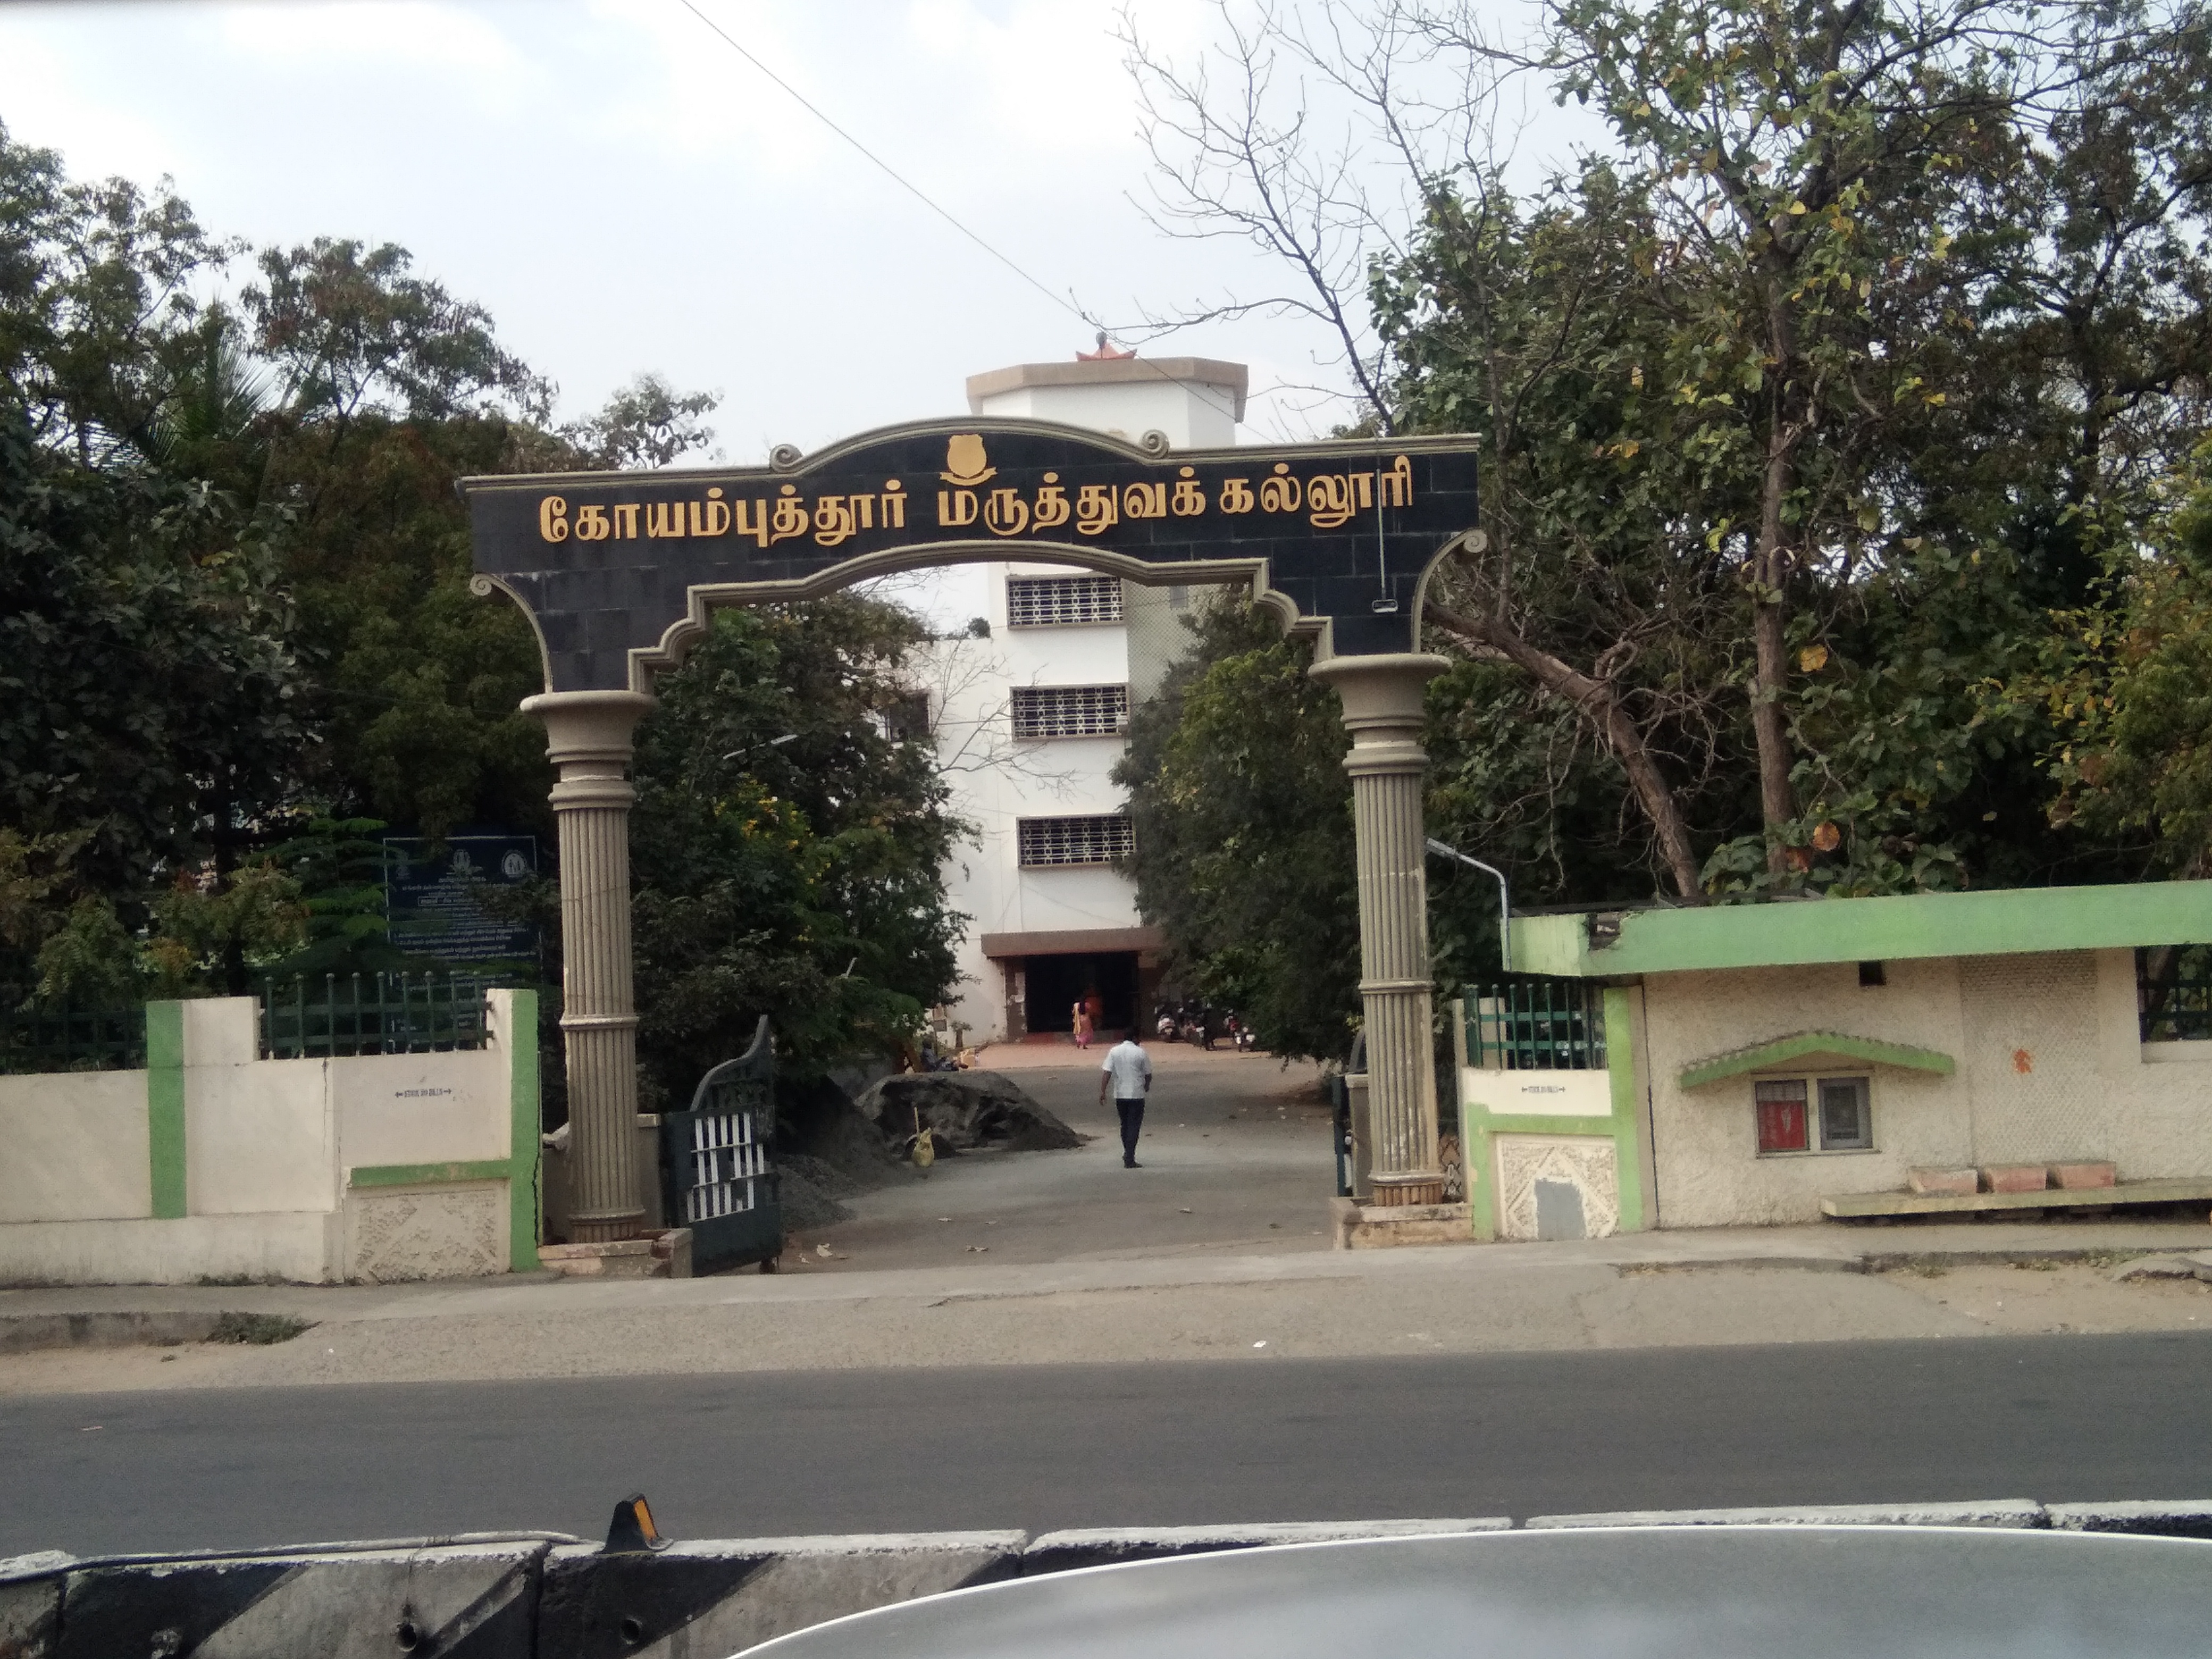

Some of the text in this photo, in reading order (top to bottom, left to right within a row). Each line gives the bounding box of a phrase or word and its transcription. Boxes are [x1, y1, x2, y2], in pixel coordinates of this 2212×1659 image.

[539, 455, 1412, 548] கோயம்புத்தூர் மருத்துவக் கல்லூரி
